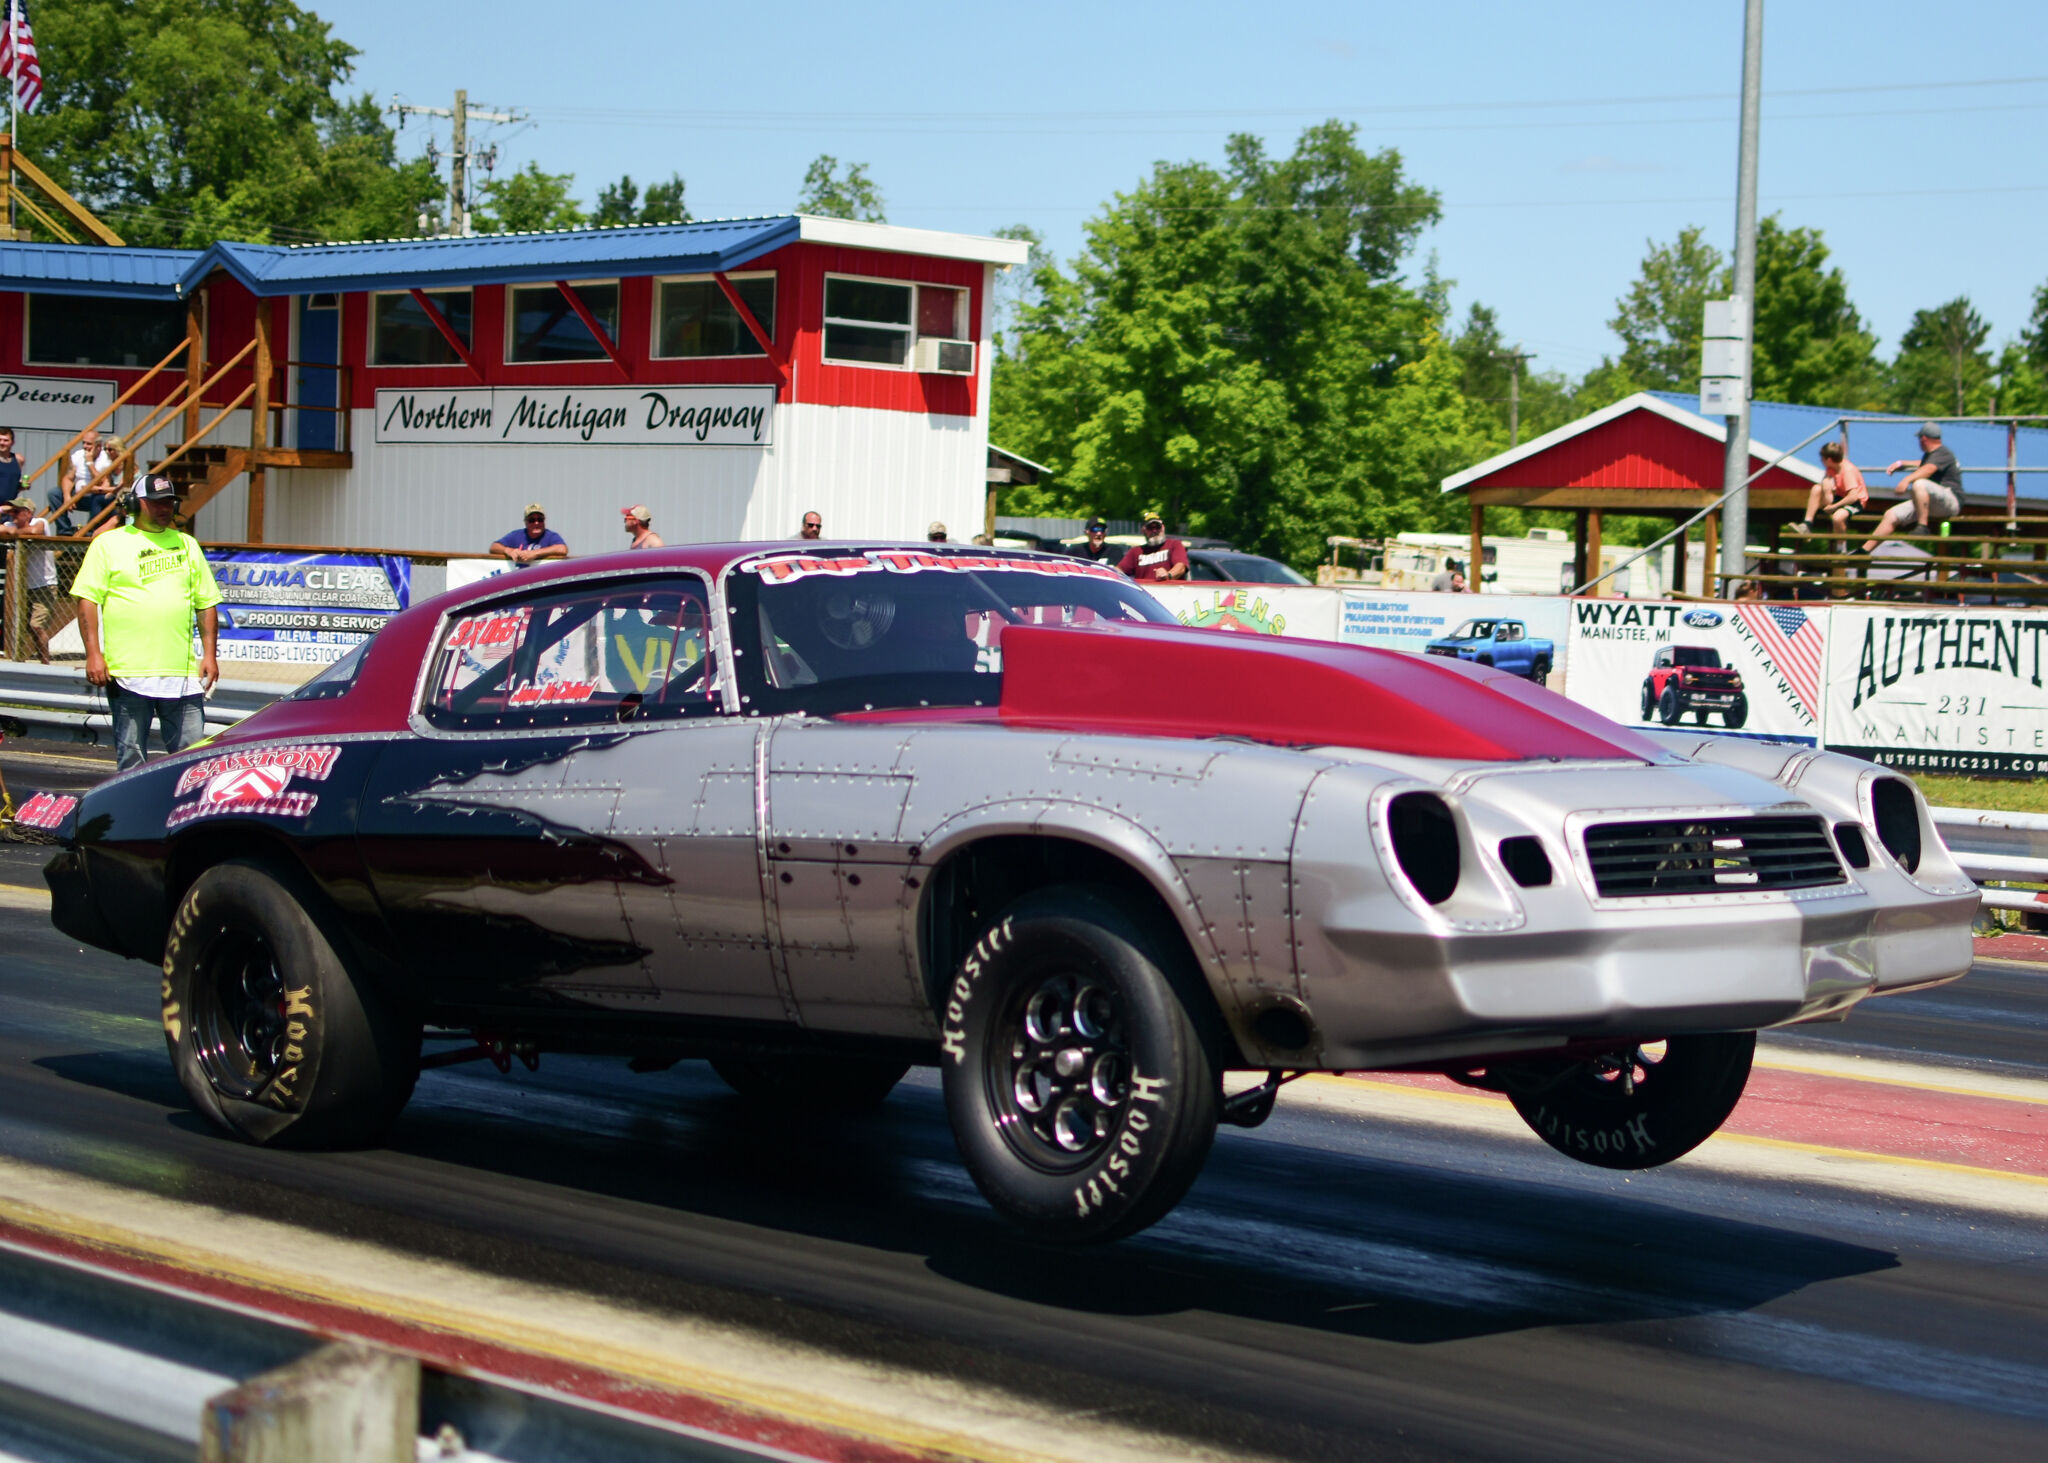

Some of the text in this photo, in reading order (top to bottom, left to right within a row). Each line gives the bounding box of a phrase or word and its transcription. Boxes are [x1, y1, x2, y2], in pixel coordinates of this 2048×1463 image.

[0, 381, 95, 404] Petersen
[384, 392, 764, 441] Northern Michigan Dragway
[138, 554, 182, 577] MICHIGAN
[229, 588, 269, 600] ULTIMATE
[270, 590, 311, 602] ALUMINUM
[312, 591, 338, 602] CLEAR
[339, 593, 361, 603] COAT
[362, 593, 394, 604] SYSTEM
[248, 612, 317, 627] PRODUCTS
[319, 615, 330, 627] &
[1577, 603, 1682, 627] WYATT
[1581, 626, 1671, 642] MANISTEE, MI
[1730, 614, 1753, 642] BUY
[1751, 643, 1765, 657] IT
[1761, 659, 1779, 678] AT
[1776, 677, 1814, 727] WYATT
[1938, 695, 1987, 716] 231
[184, 751, 331, 789] SAXTON
[942, 915, 1014, 1064] Hoosier
[1075, 1065, 1170, 1218] Hoosier
